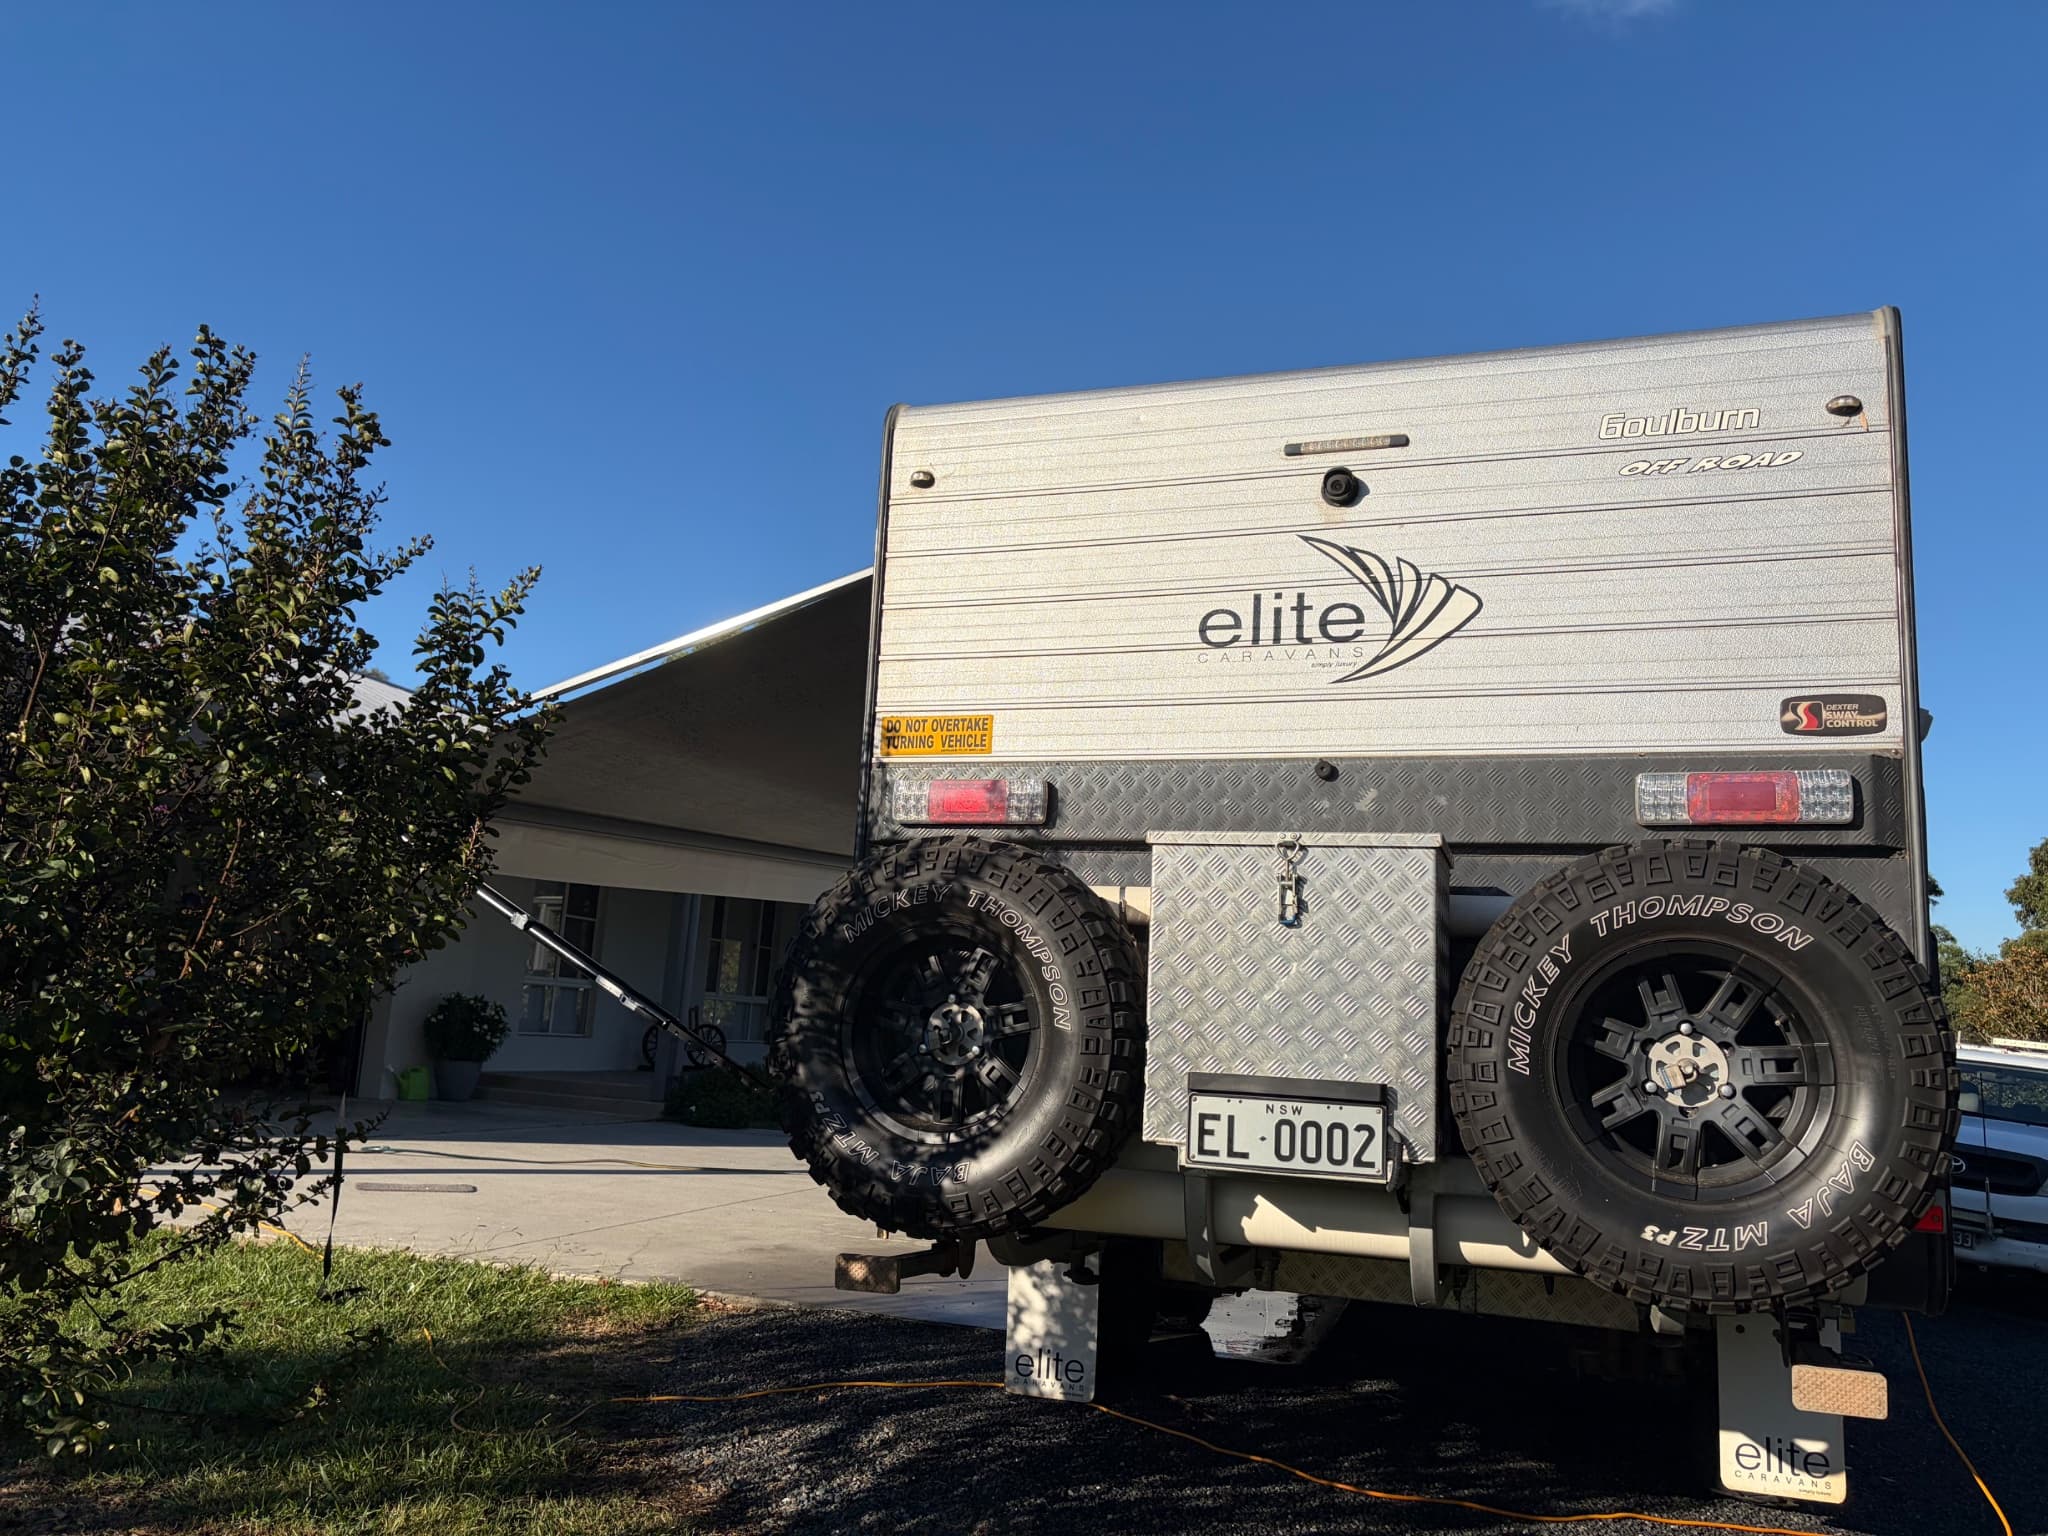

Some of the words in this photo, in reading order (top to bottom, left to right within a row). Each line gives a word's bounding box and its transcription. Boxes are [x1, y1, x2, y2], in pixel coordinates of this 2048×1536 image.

[1599, 408, 1760, 440] Goulburn
[1618, 457, 1690, 476] OFF
[1687, 451, 1804, 474] ROAD
[1199, 592, 1365, 648] elite
[1198, 646, 1364, 664] CARAVANS
[1826, 703, 1859, 711] DEXTER
[1826, 711, 1859, 719] SWAY
[886, 719, 901, 733] DO
[905, 719, 928, 733] NOT
[931, 717, 989, 733] OVERTAKE
[1826, 719, 1878, 728] CONTROL
[886, 734, 934, 749] TURNING
[941, 733, 987, 749] VEHICLE
[842, 884, 952, 944] MICKEY
[967, 889, 1073, 1032] THOMPSON
[1507, 933, 1574, 1077] MICKEY
[1590, 894, 1814, 953] THOMPSON
[1265, 1103, 1303, 1116] NSW
[890, 1160, 970, 1186] BAJA
[1786, 1141, 1875, 1231] BAJA
[1015, 1348, 1085, 1383] elite
[1735, 1436, 1831, 1479] elite
[1734, 1470, 1832, 1490] CARAVANS
